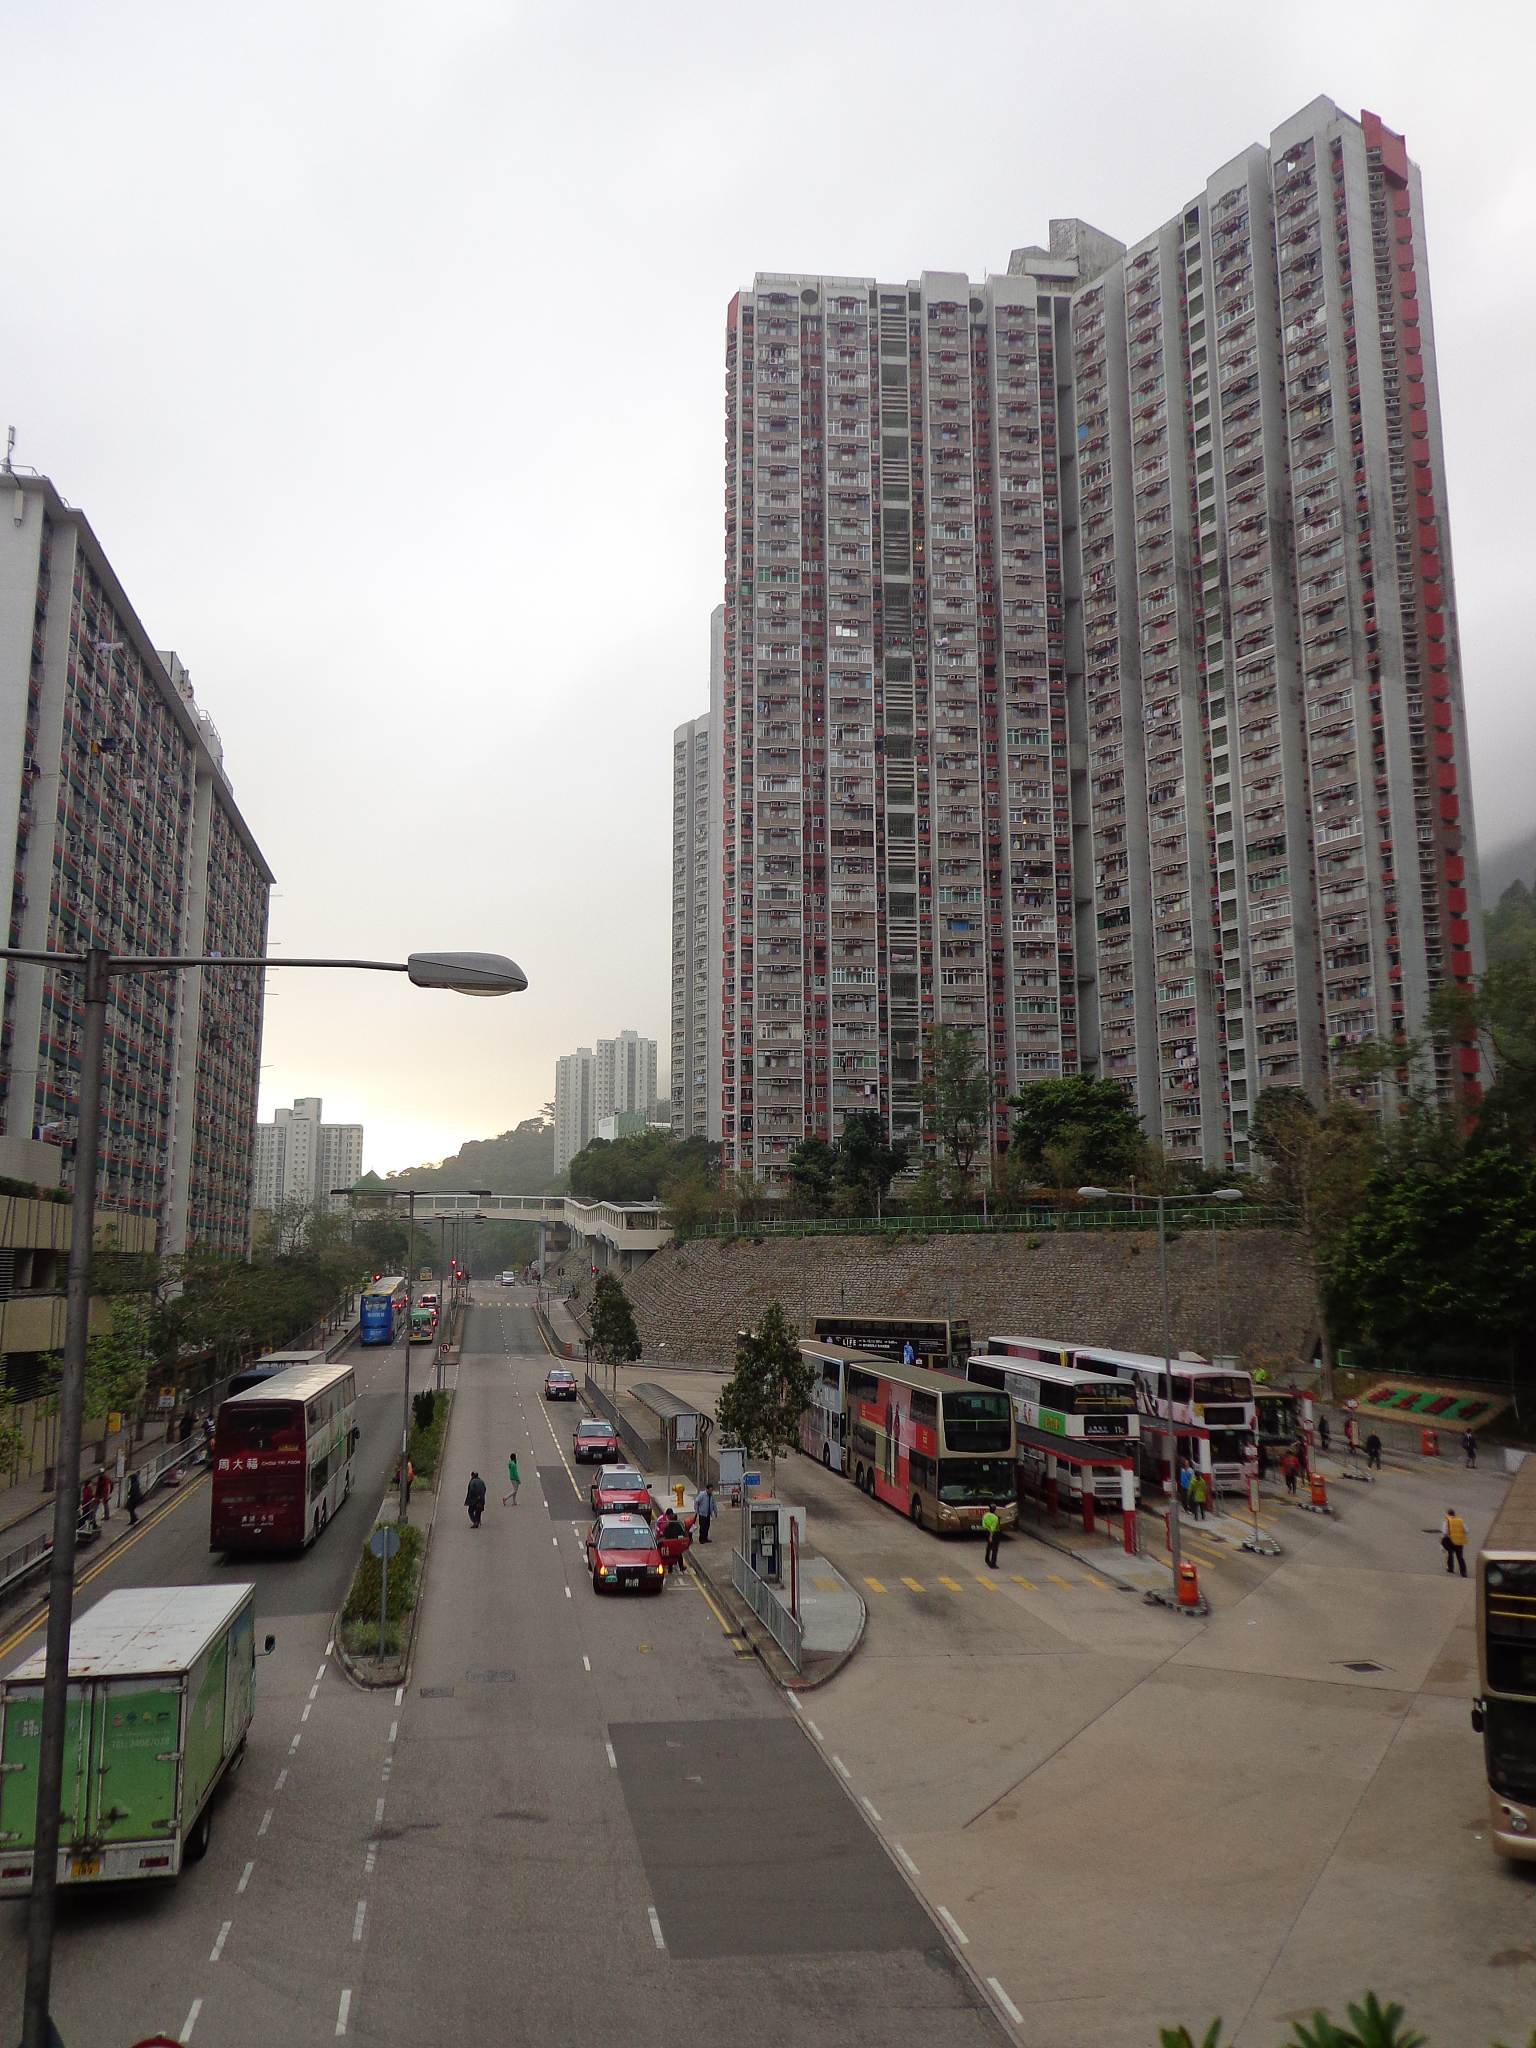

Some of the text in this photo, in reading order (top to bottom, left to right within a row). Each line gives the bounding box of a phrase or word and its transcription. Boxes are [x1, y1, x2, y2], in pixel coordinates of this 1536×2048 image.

[842, 1338, 857, 1347] LIFE
[217, 1457, 258, 1471] 周大福
